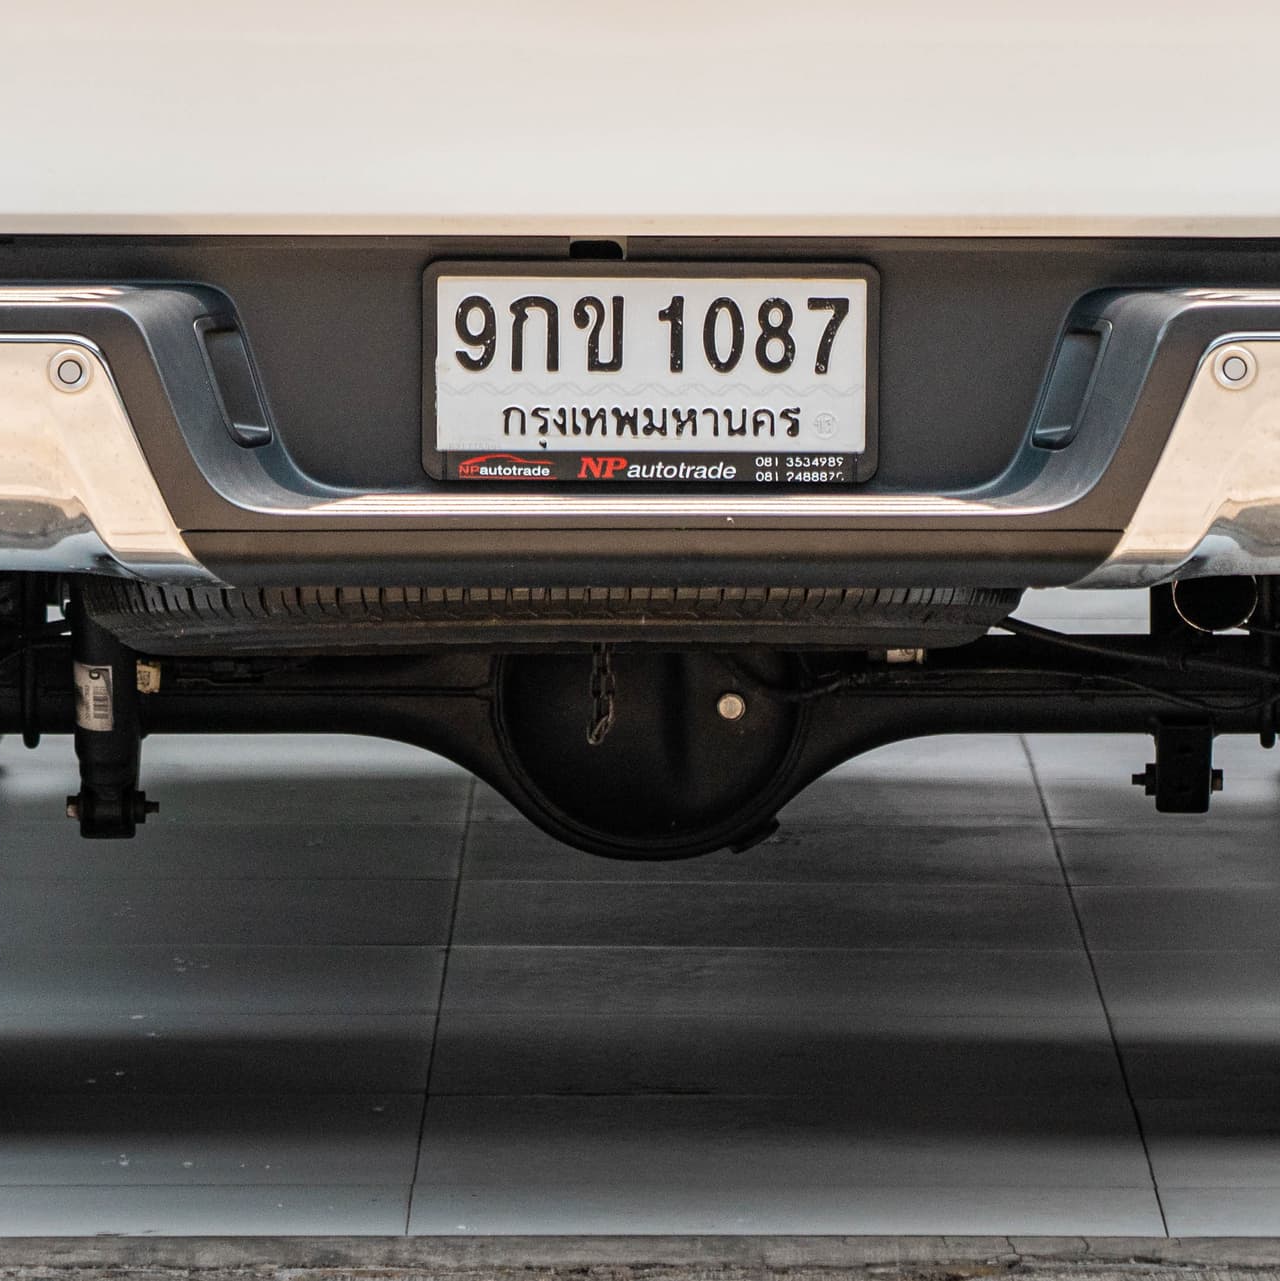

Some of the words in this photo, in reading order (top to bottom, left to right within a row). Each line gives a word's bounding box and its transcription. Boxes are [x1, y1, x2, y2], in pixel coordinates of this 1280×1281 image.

[454, 295, 624, 373] 9กข
[658, 295, 850, 374] 1087
[502, 405, 801, 449] กรุงเทพมหานคร
[755, 456, 780, 468] 081
[755, 471, 780, 483] 081
